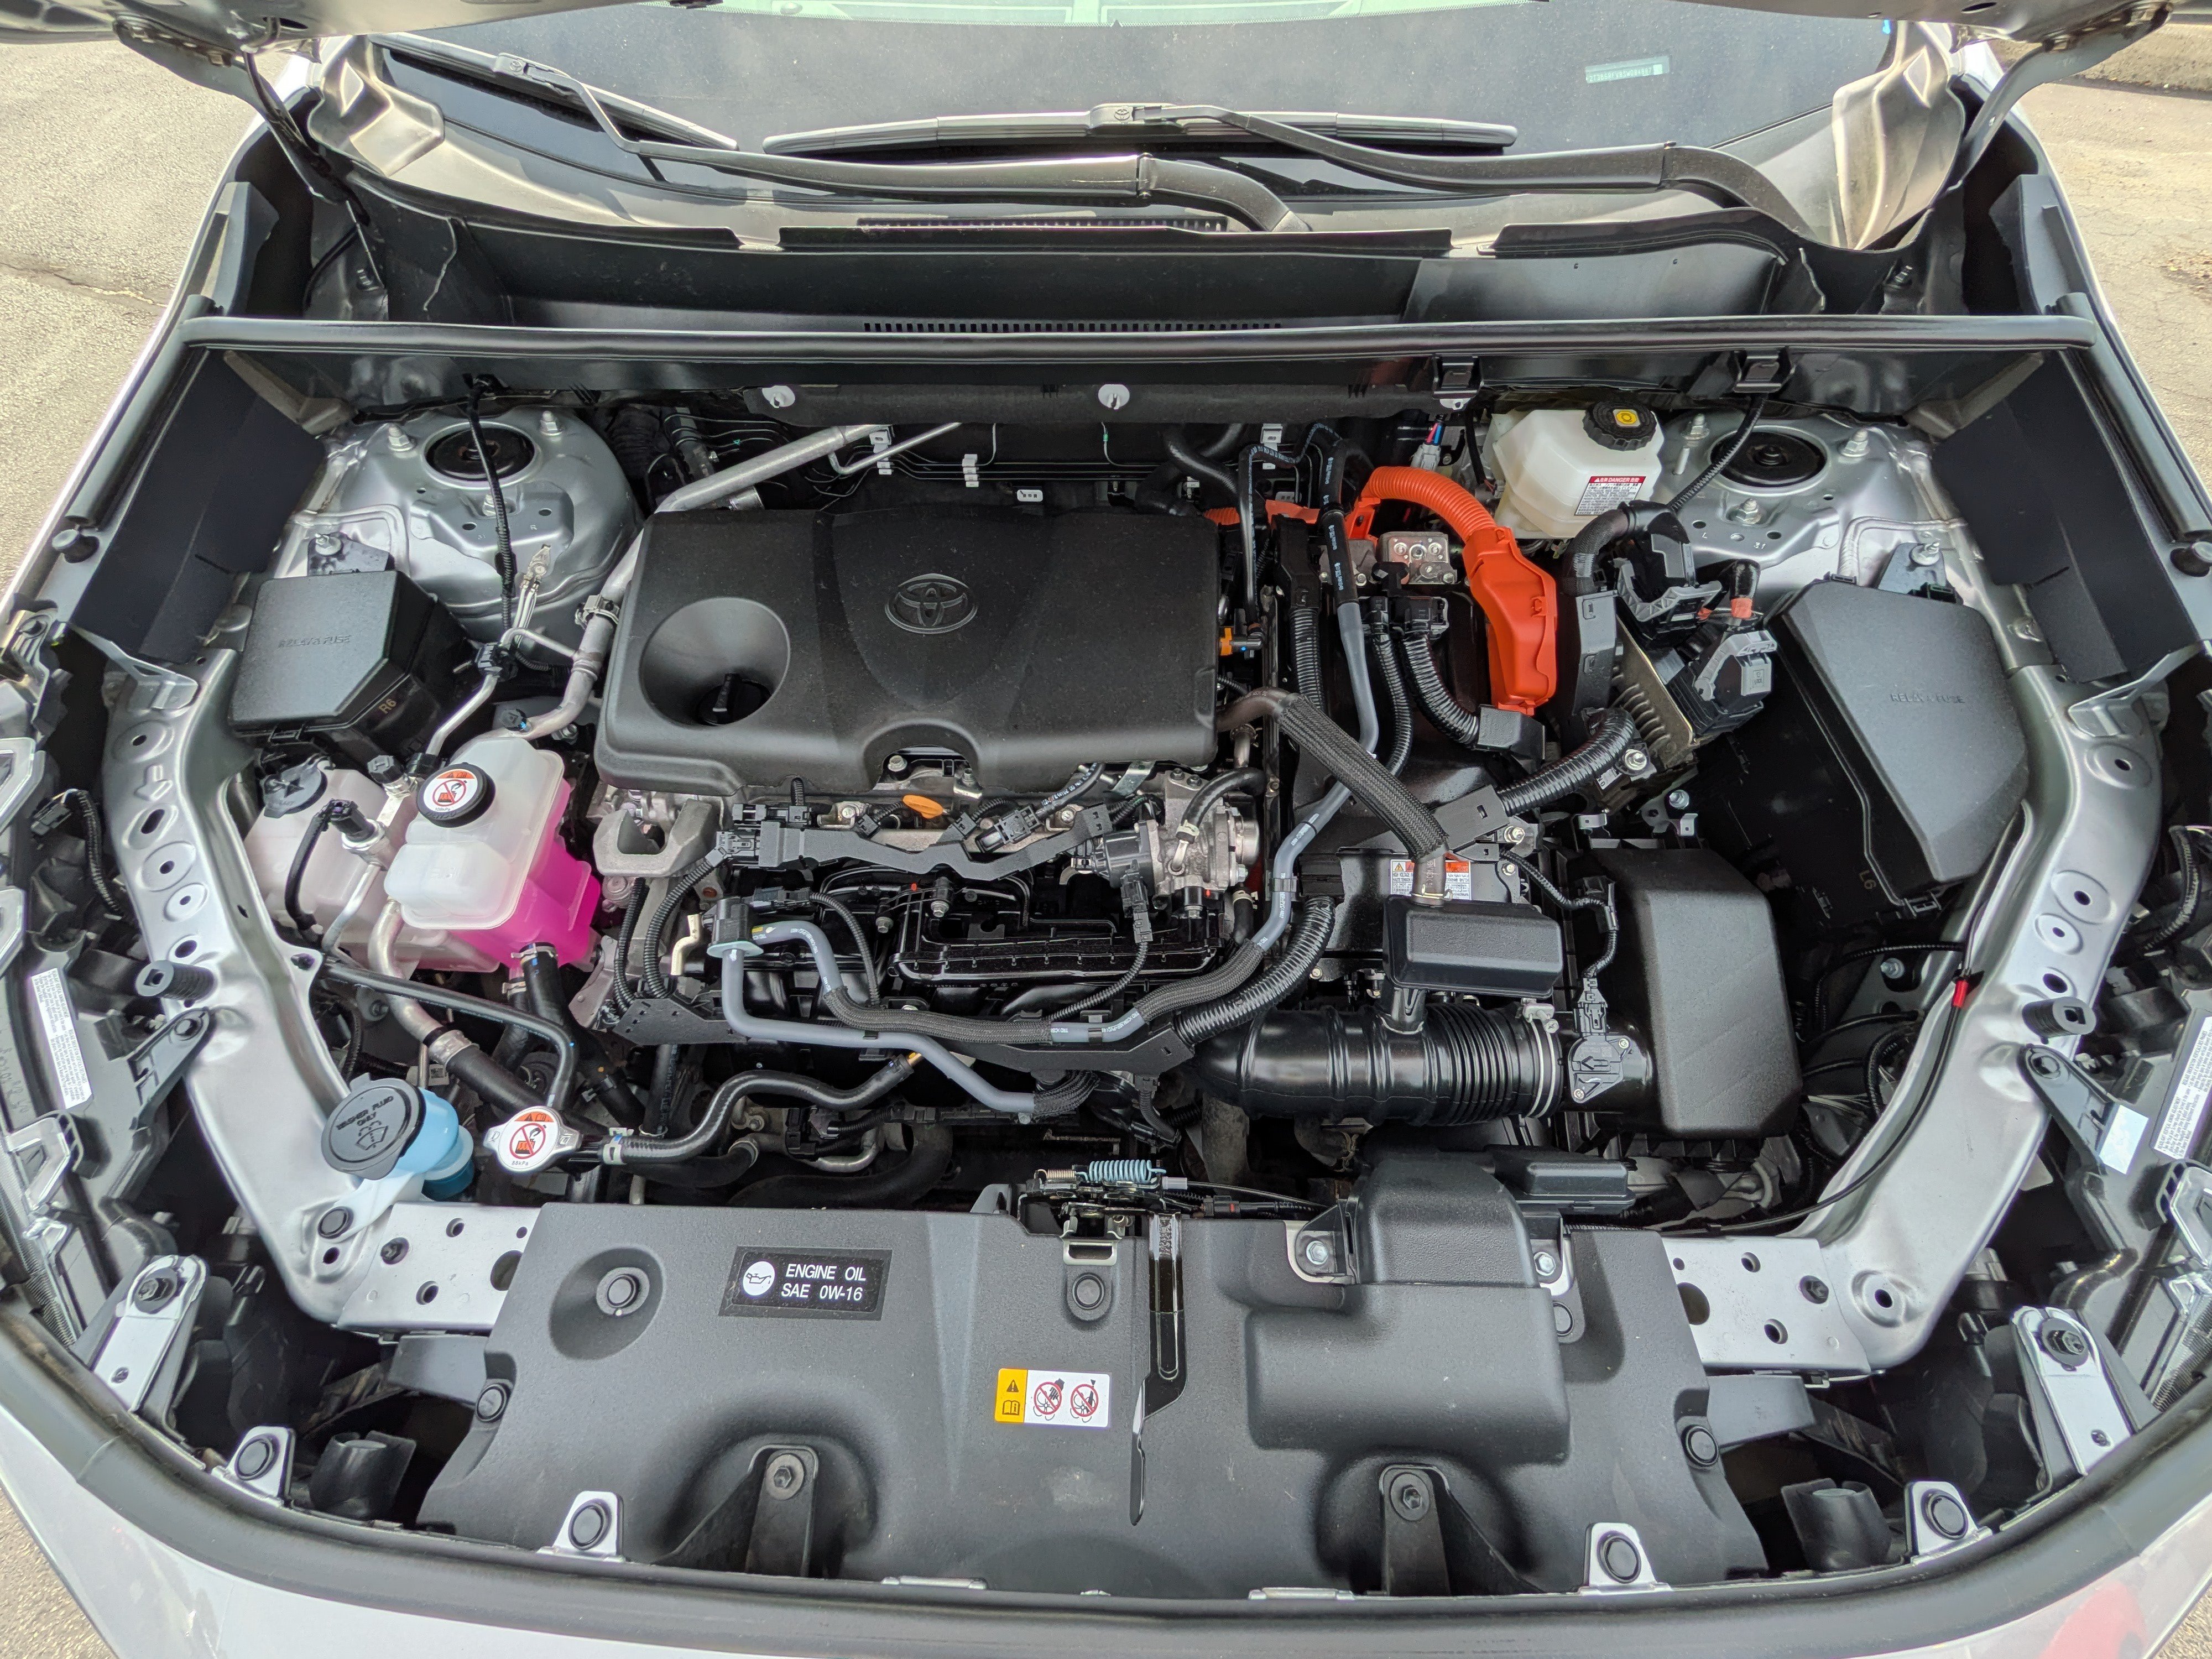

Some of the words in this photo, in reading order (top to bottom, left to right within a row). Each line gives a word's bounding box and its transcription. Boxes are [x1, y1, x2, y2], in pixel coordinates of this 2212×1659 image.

[323, 634, 352, 645] FUSE
[378, 698, 397, 714] R6
[1859, 869, 1877, 890] L6
[336, 1109, 369, 1130] WASHER
[357, 1112, 377, 1126] ONLY
[785, 1263, 837, 1280] ENGINE
[844, 1266, 867, 1281] OIL
[781, 1283, 811, 1298] SAE
[819, 1285, 863, 1301] 0W-16
